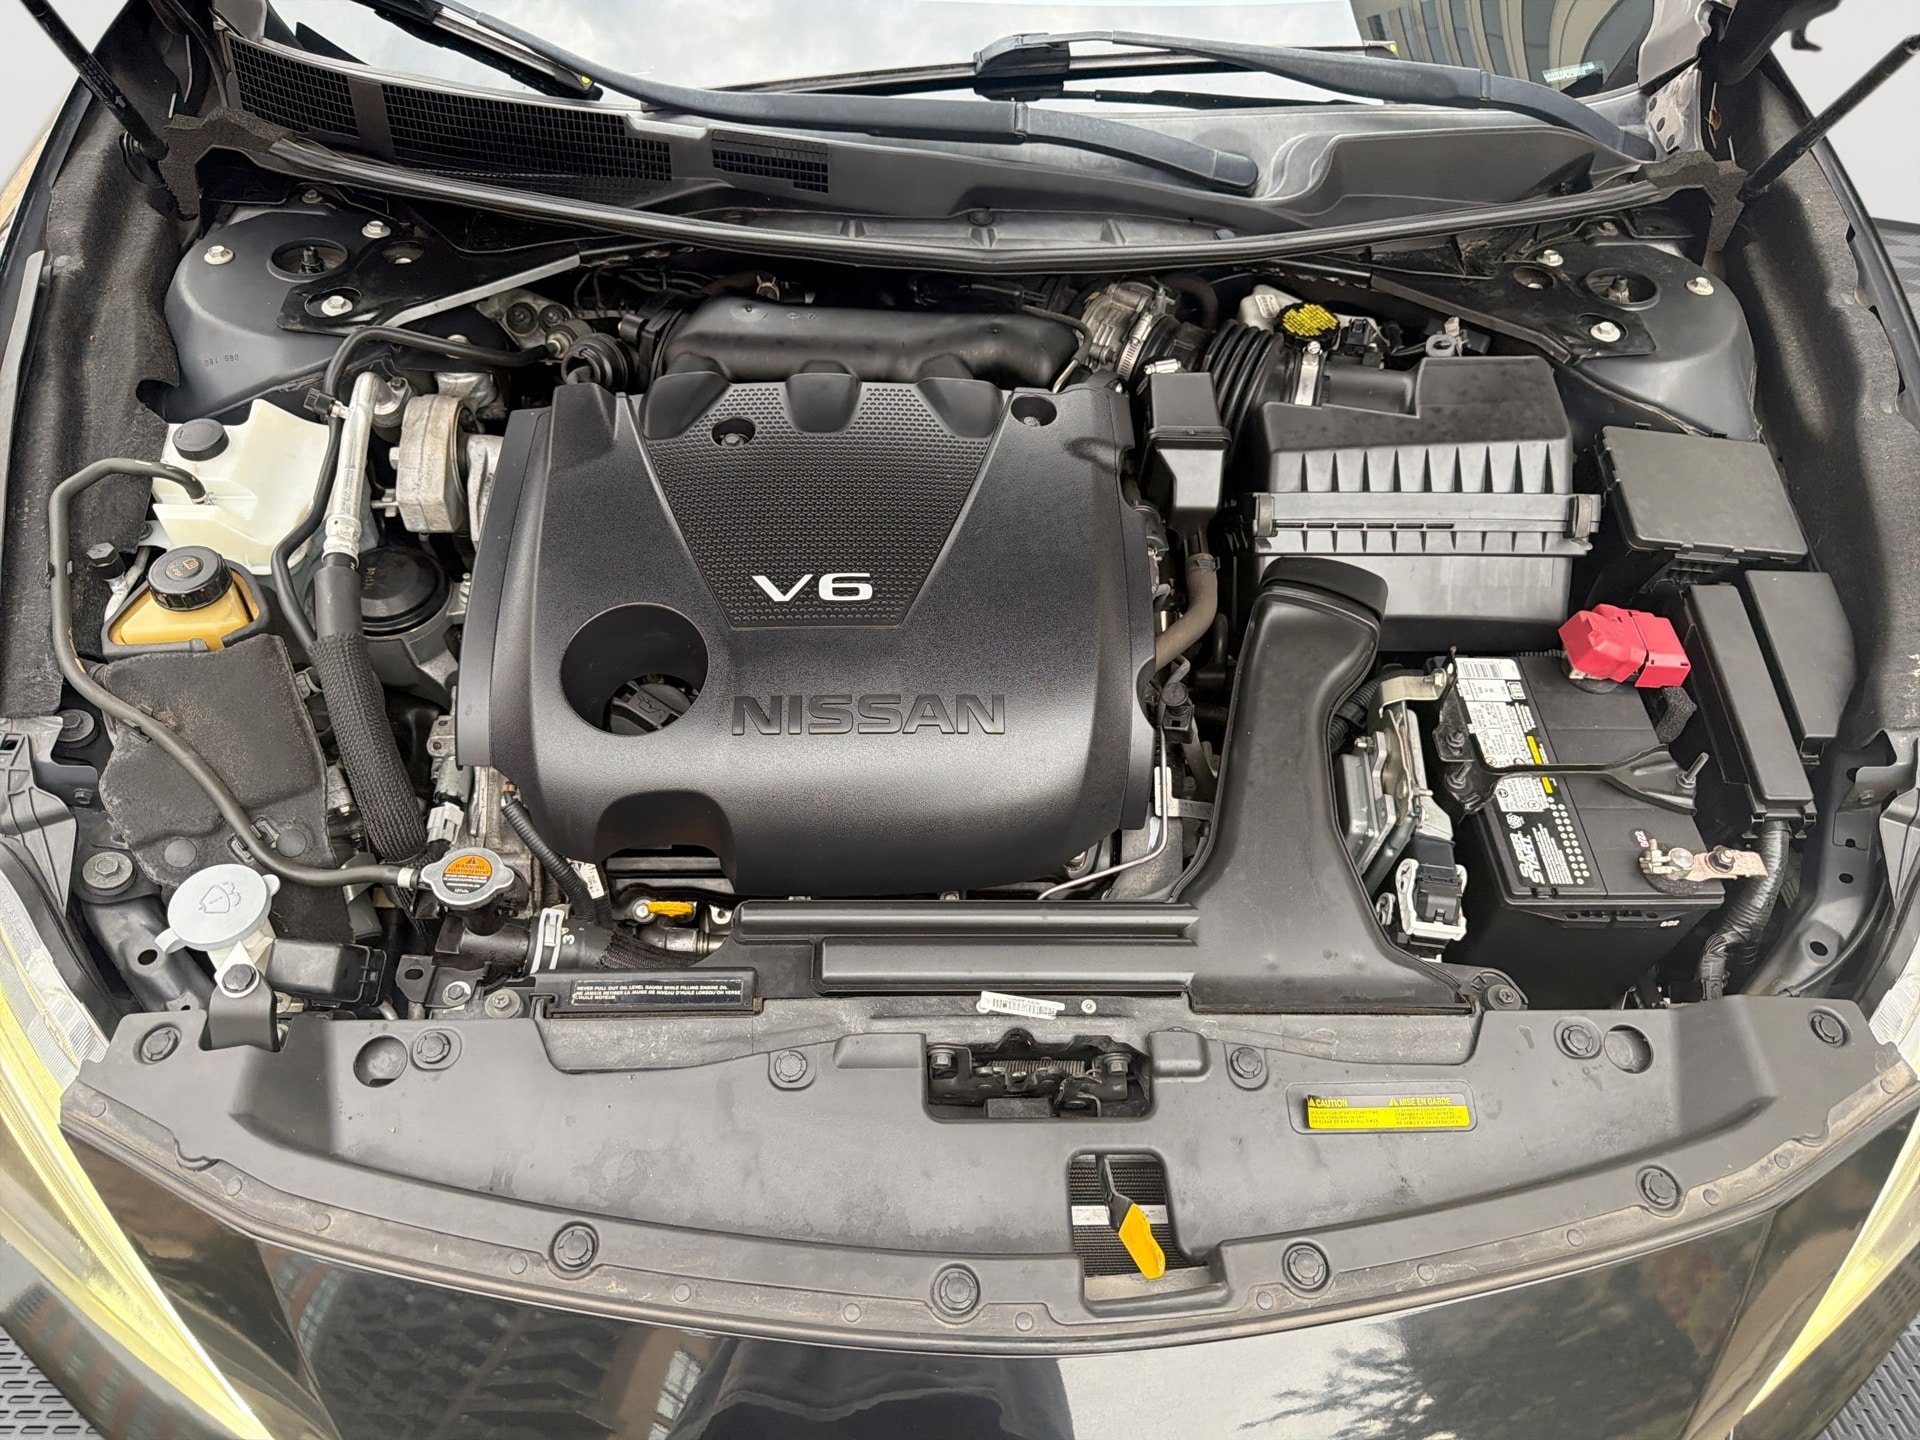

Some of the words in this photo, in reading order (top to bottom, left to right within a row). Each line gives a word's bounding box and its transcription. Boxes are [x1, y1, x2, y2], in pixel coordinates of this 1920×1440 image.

[751, 572, 873, 602] V6
[731, 694, 1006, 735] NISSAN
[1509, 833, 1530, 876] SUPER
[1316, 1098, 1348, 1107] CAUTION
[1399, 1097, 1417, 1106] MISE
[1417, 1097, 1426, 1106] EN
[1427, 1097, 1451, 1105] GARDE
